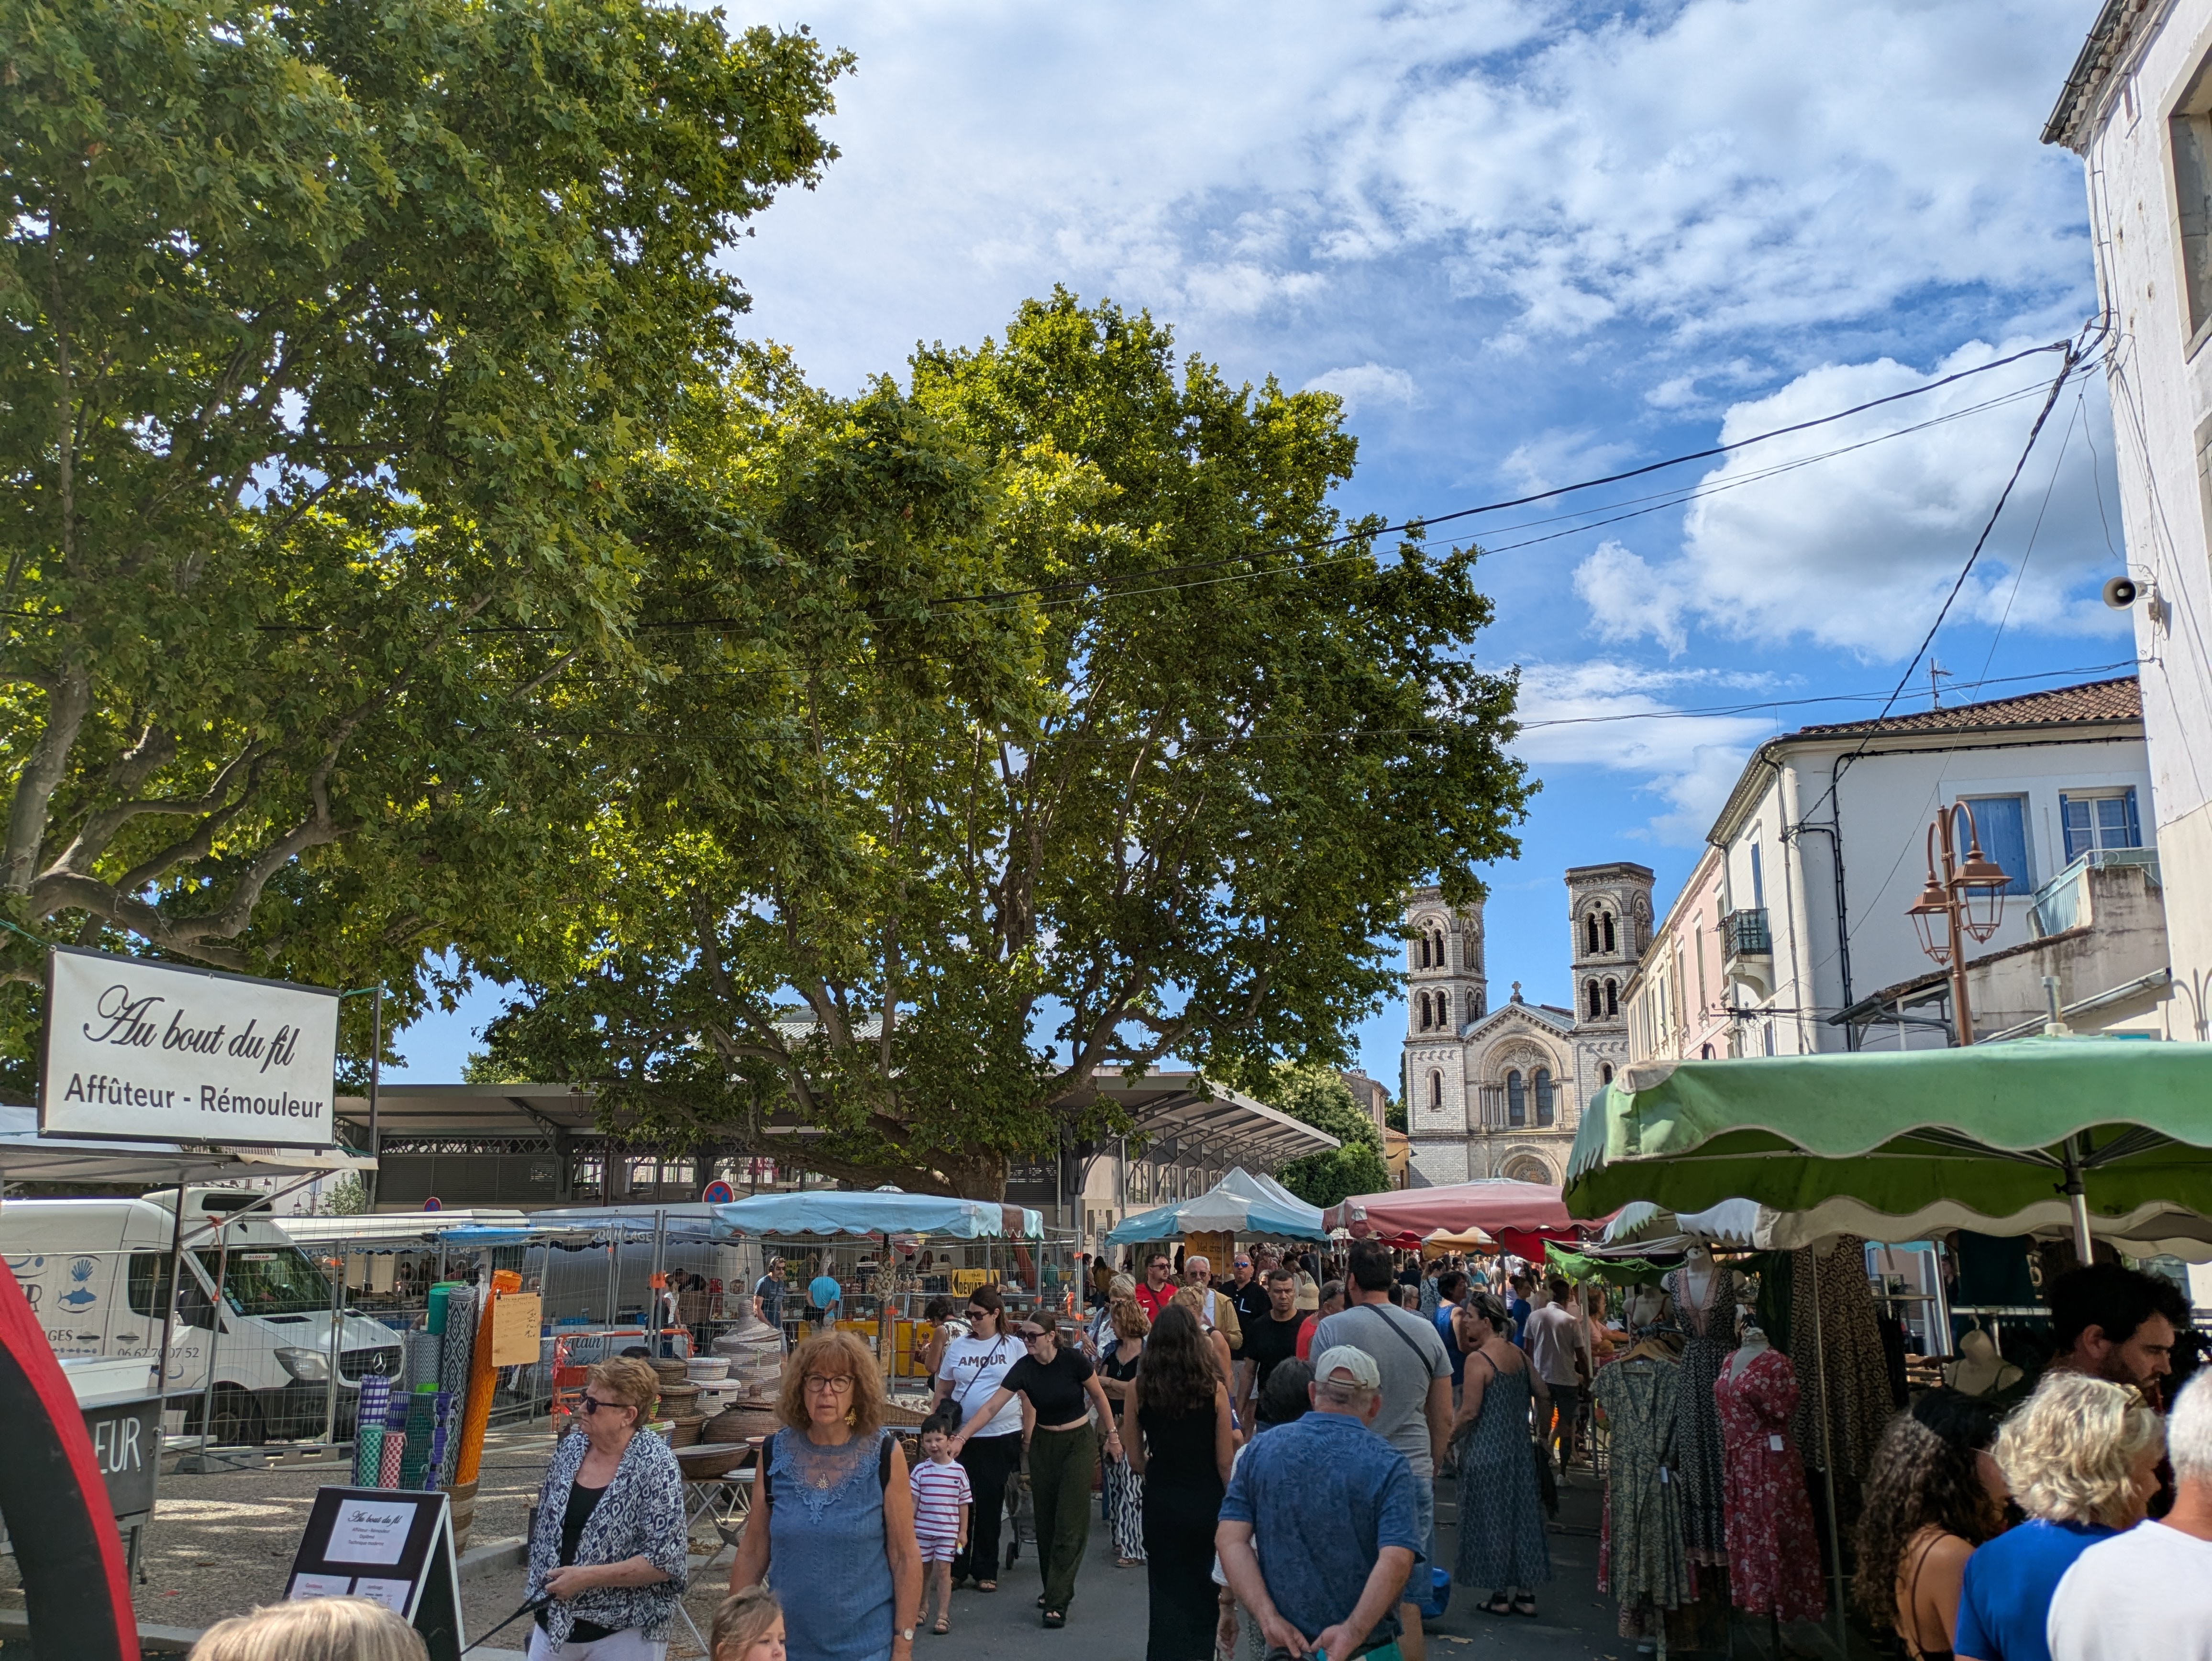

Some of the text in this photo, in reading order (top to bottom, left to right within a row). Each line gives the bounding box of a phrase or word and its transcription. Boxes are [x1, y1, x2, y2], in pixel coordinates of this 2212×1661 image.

[83, 985, 300, 1074] Au bout du fil
[65, 1073, 175, 1108] Affûteur
[201, 1085, 324, 1118] Rémouleur
[959, 1279, 984, 1295] DÉVIAT
[44, 1329, 74, 1341] GES
[185, 1347, 199, 1358] 52
[958, 1354, 1007, 1368] AMOUR
[348, 1510, 403, 1527] Au bout du fil
